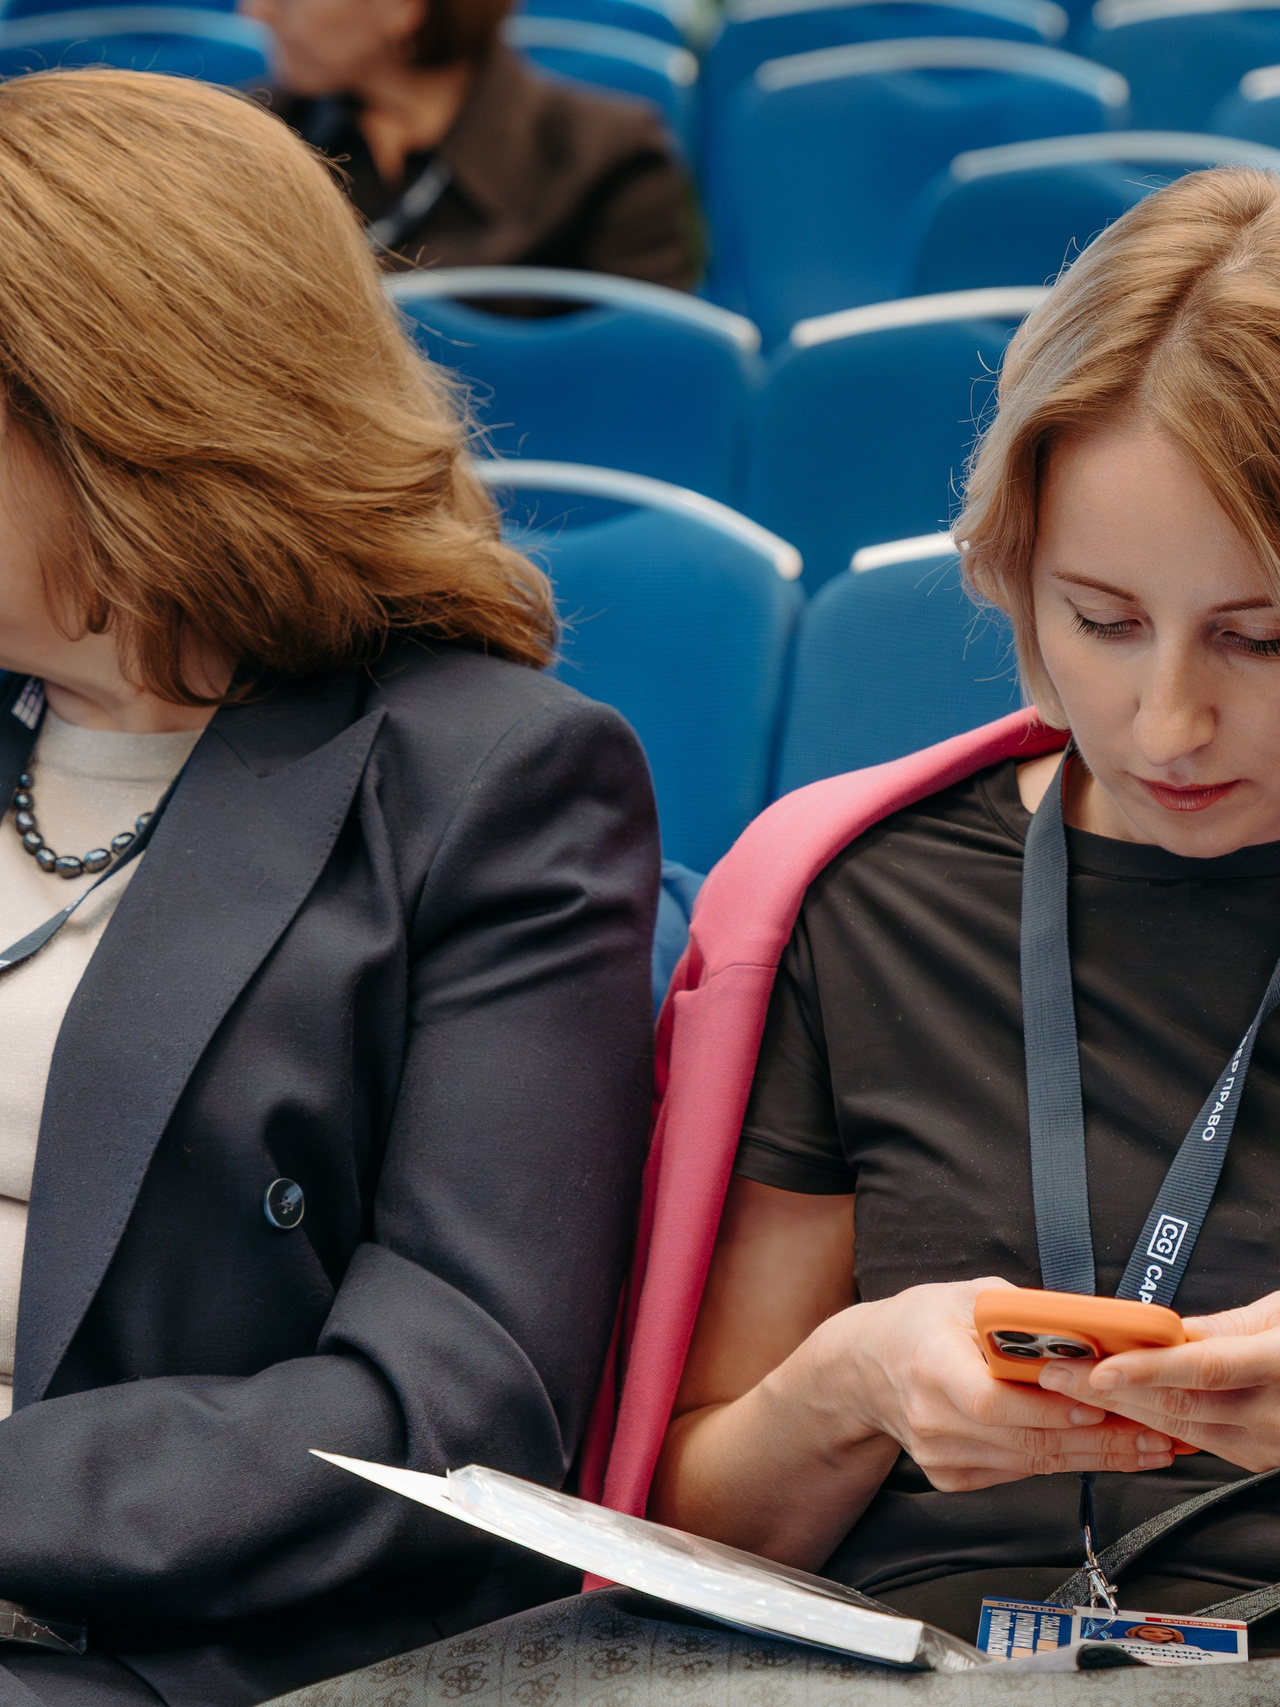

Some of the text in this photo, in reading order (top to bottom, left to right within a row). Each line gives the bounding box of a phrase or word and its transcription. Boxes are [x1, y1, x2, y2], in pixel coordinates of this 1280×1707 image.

[1202, 1076, 1236, 1142] ПРАВО
[1138, 1219, 1182, 1305] CG CAP
[997, 1602, 1057, 1613] SPEAKER
[1160, 1618, 1228, 1628] DEVELOPMENT
[1120, 1644, 1214, 1658] ТЯЖКИНА
[1126, 1650, 1203, 1661] ВГЕНИЯ
